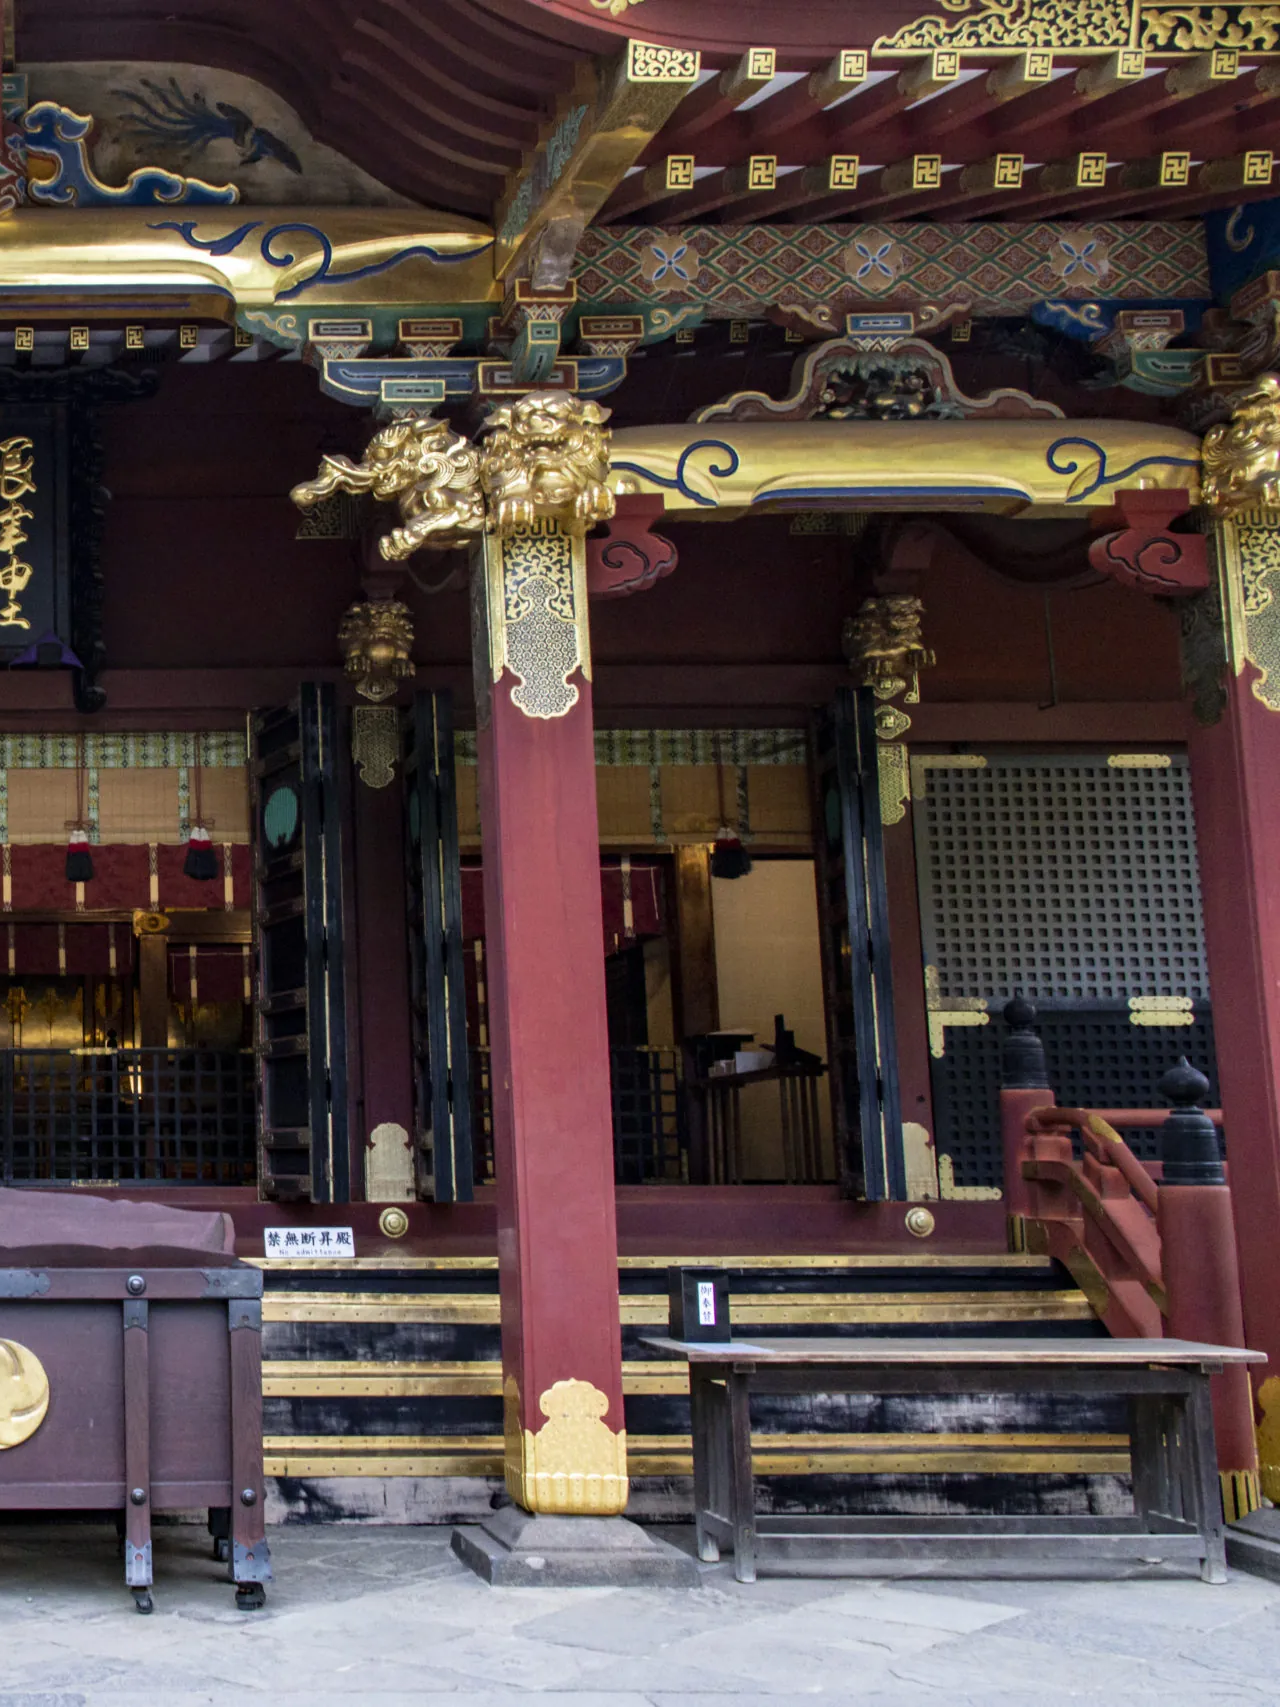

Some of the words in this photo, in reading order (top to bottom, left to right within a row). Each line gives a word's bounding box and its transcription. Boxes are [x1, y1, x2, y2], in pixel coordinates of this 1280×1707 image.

[267, 1231, 352, 1247] 禁無断昇殿
